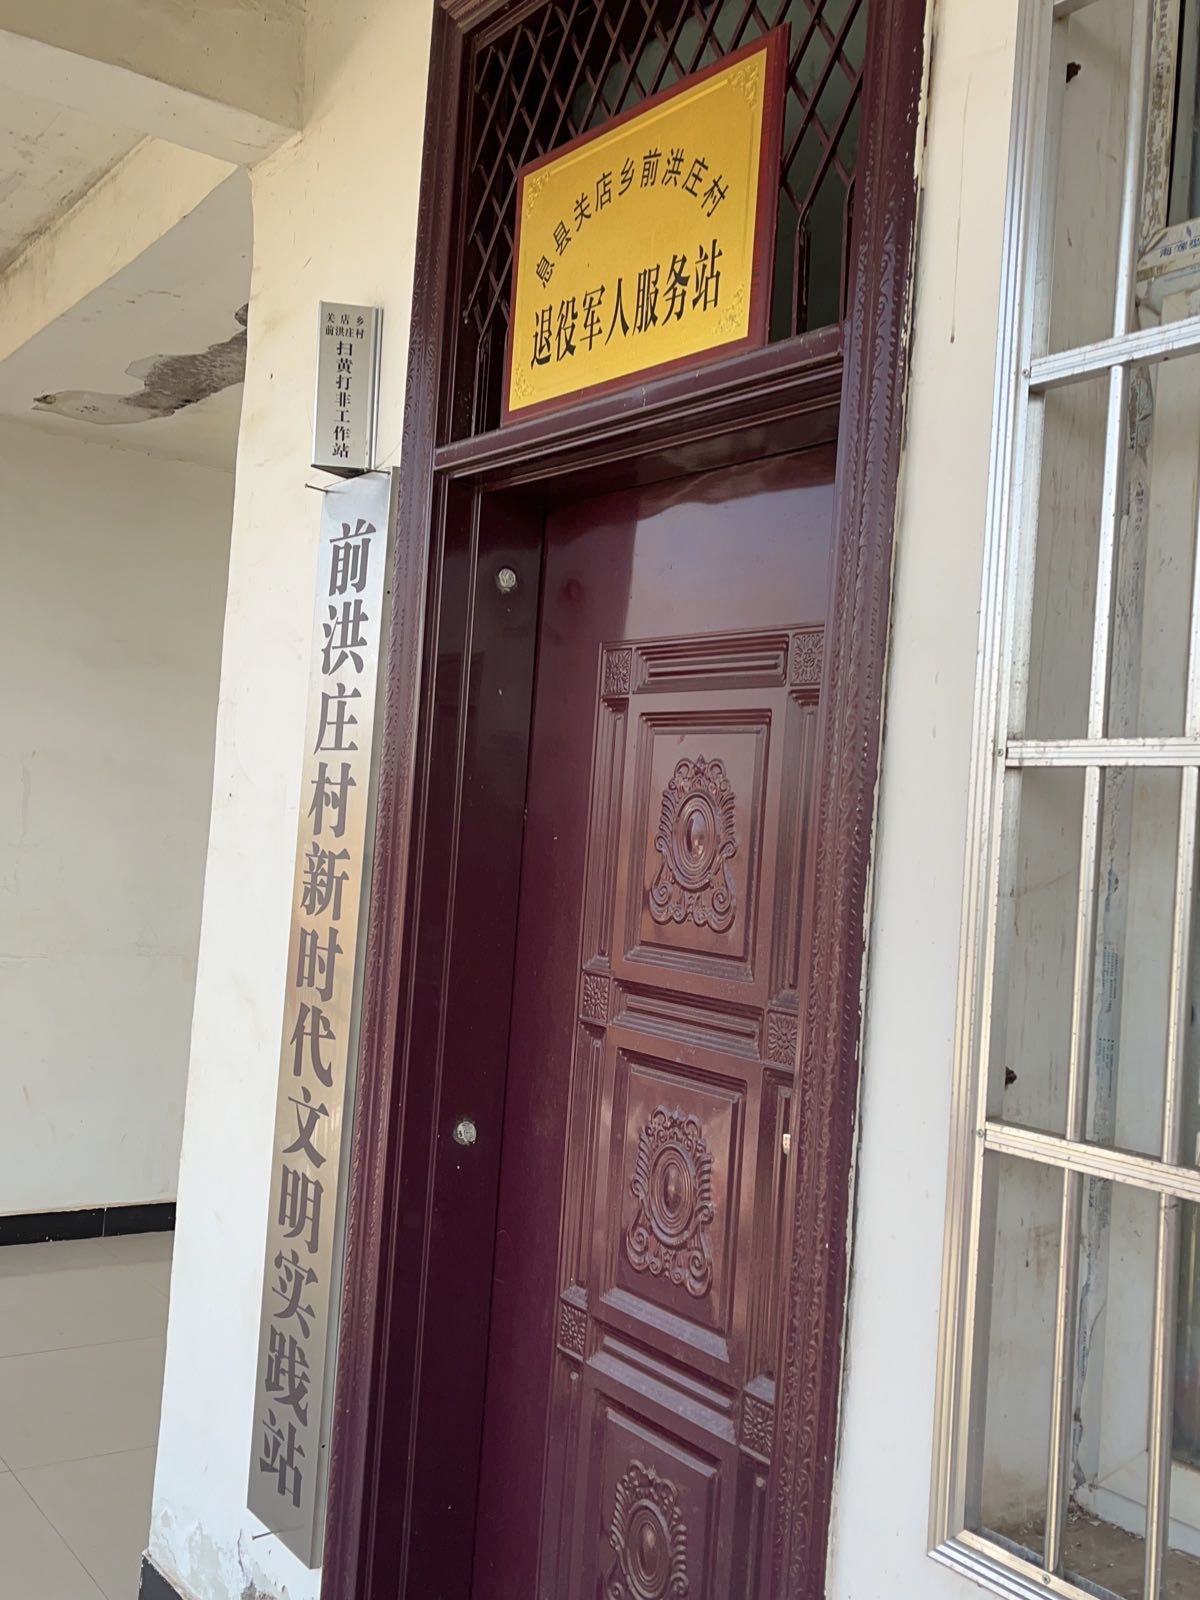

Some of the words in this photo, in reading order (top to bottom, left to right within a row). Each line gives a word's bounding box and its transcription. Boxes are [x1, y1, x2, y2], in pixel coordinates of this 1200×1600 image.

[535, 147, 730, 289] 息县关店乡前洪庄村
[325, 325, 365, 339] 前洪庄村
[530, 238, 723, 370] 退役军人服务站
[331, 340, 353, 459] 扫黄打非工作站
[259, 518, 376, 1508] 前洪庄村新时代文明实践站
